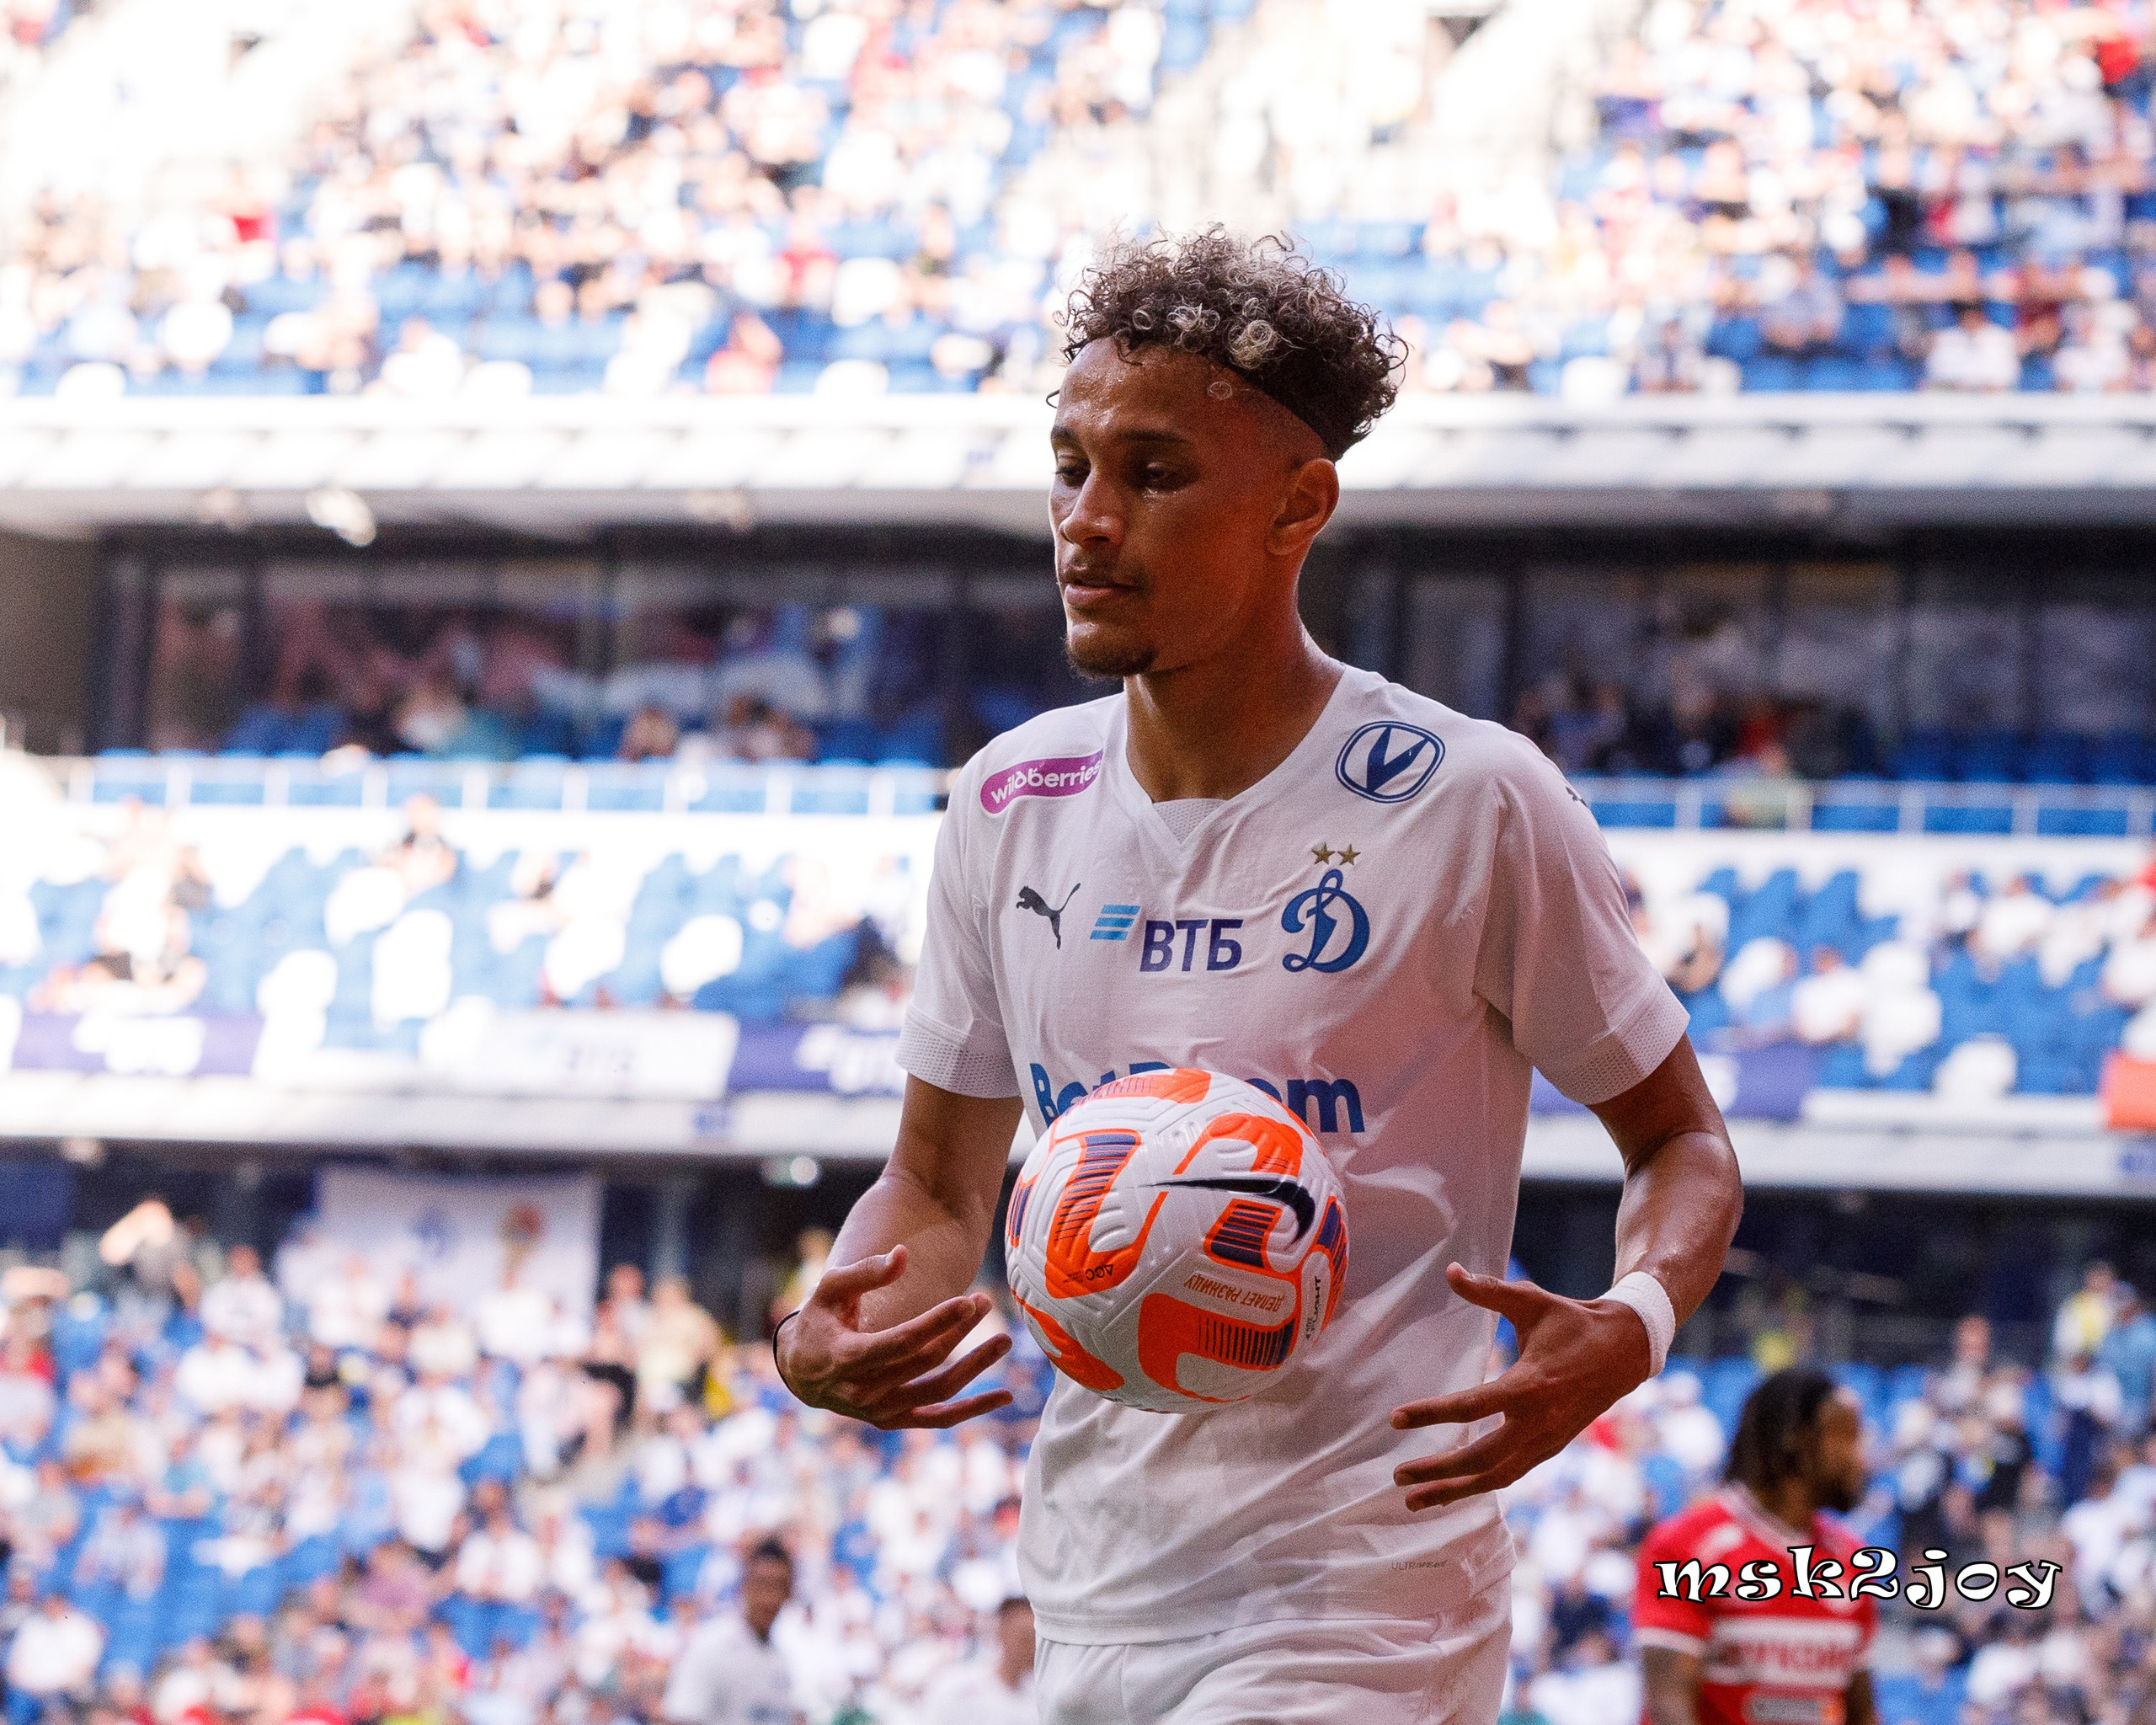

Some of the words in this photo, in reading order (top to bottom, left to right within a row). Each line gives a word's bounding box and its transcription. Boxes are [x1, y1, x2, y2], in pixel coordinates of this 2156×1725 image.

[990, 760, 1102, 804] wildberries
[1139, 918, 1245, 973] ВТБ
[1183, 1274, 1240, 1303] РАЗНИЦУ
[1241, 1291, 1284, 1312] ДЕЛАЕТ
